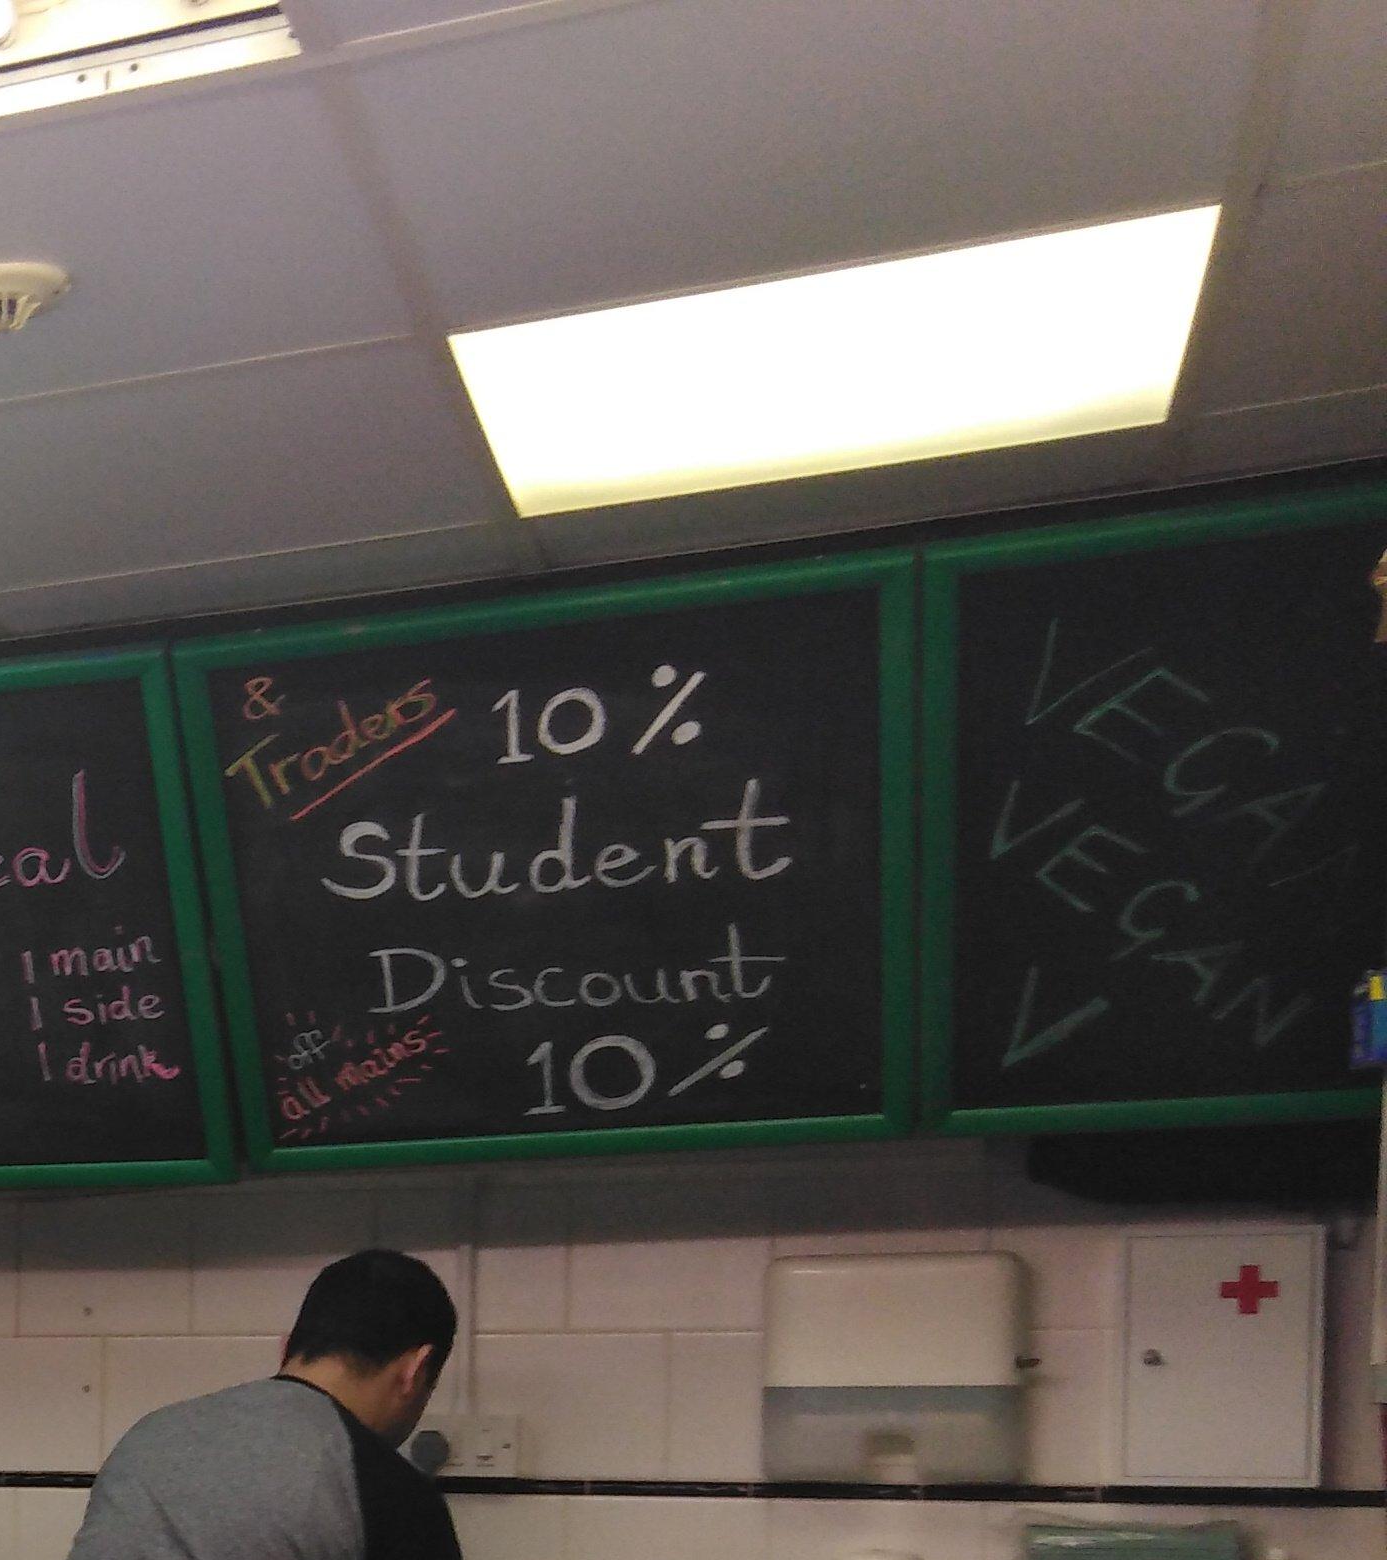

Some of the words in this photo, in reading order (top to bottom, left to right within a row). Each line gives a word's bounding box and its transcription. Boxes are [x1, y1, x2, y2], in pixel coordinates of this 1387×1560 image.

[241, 676, 287, 722] &
[224, 678, 439, 809] Traders
[321, 777, 794, 903] Student
[49, 925, 163, 977] main
[367, 922, 787, 1016] Discount
[62, 985, 165, 1026] side
[64, 1041, 181, 1086] drink
